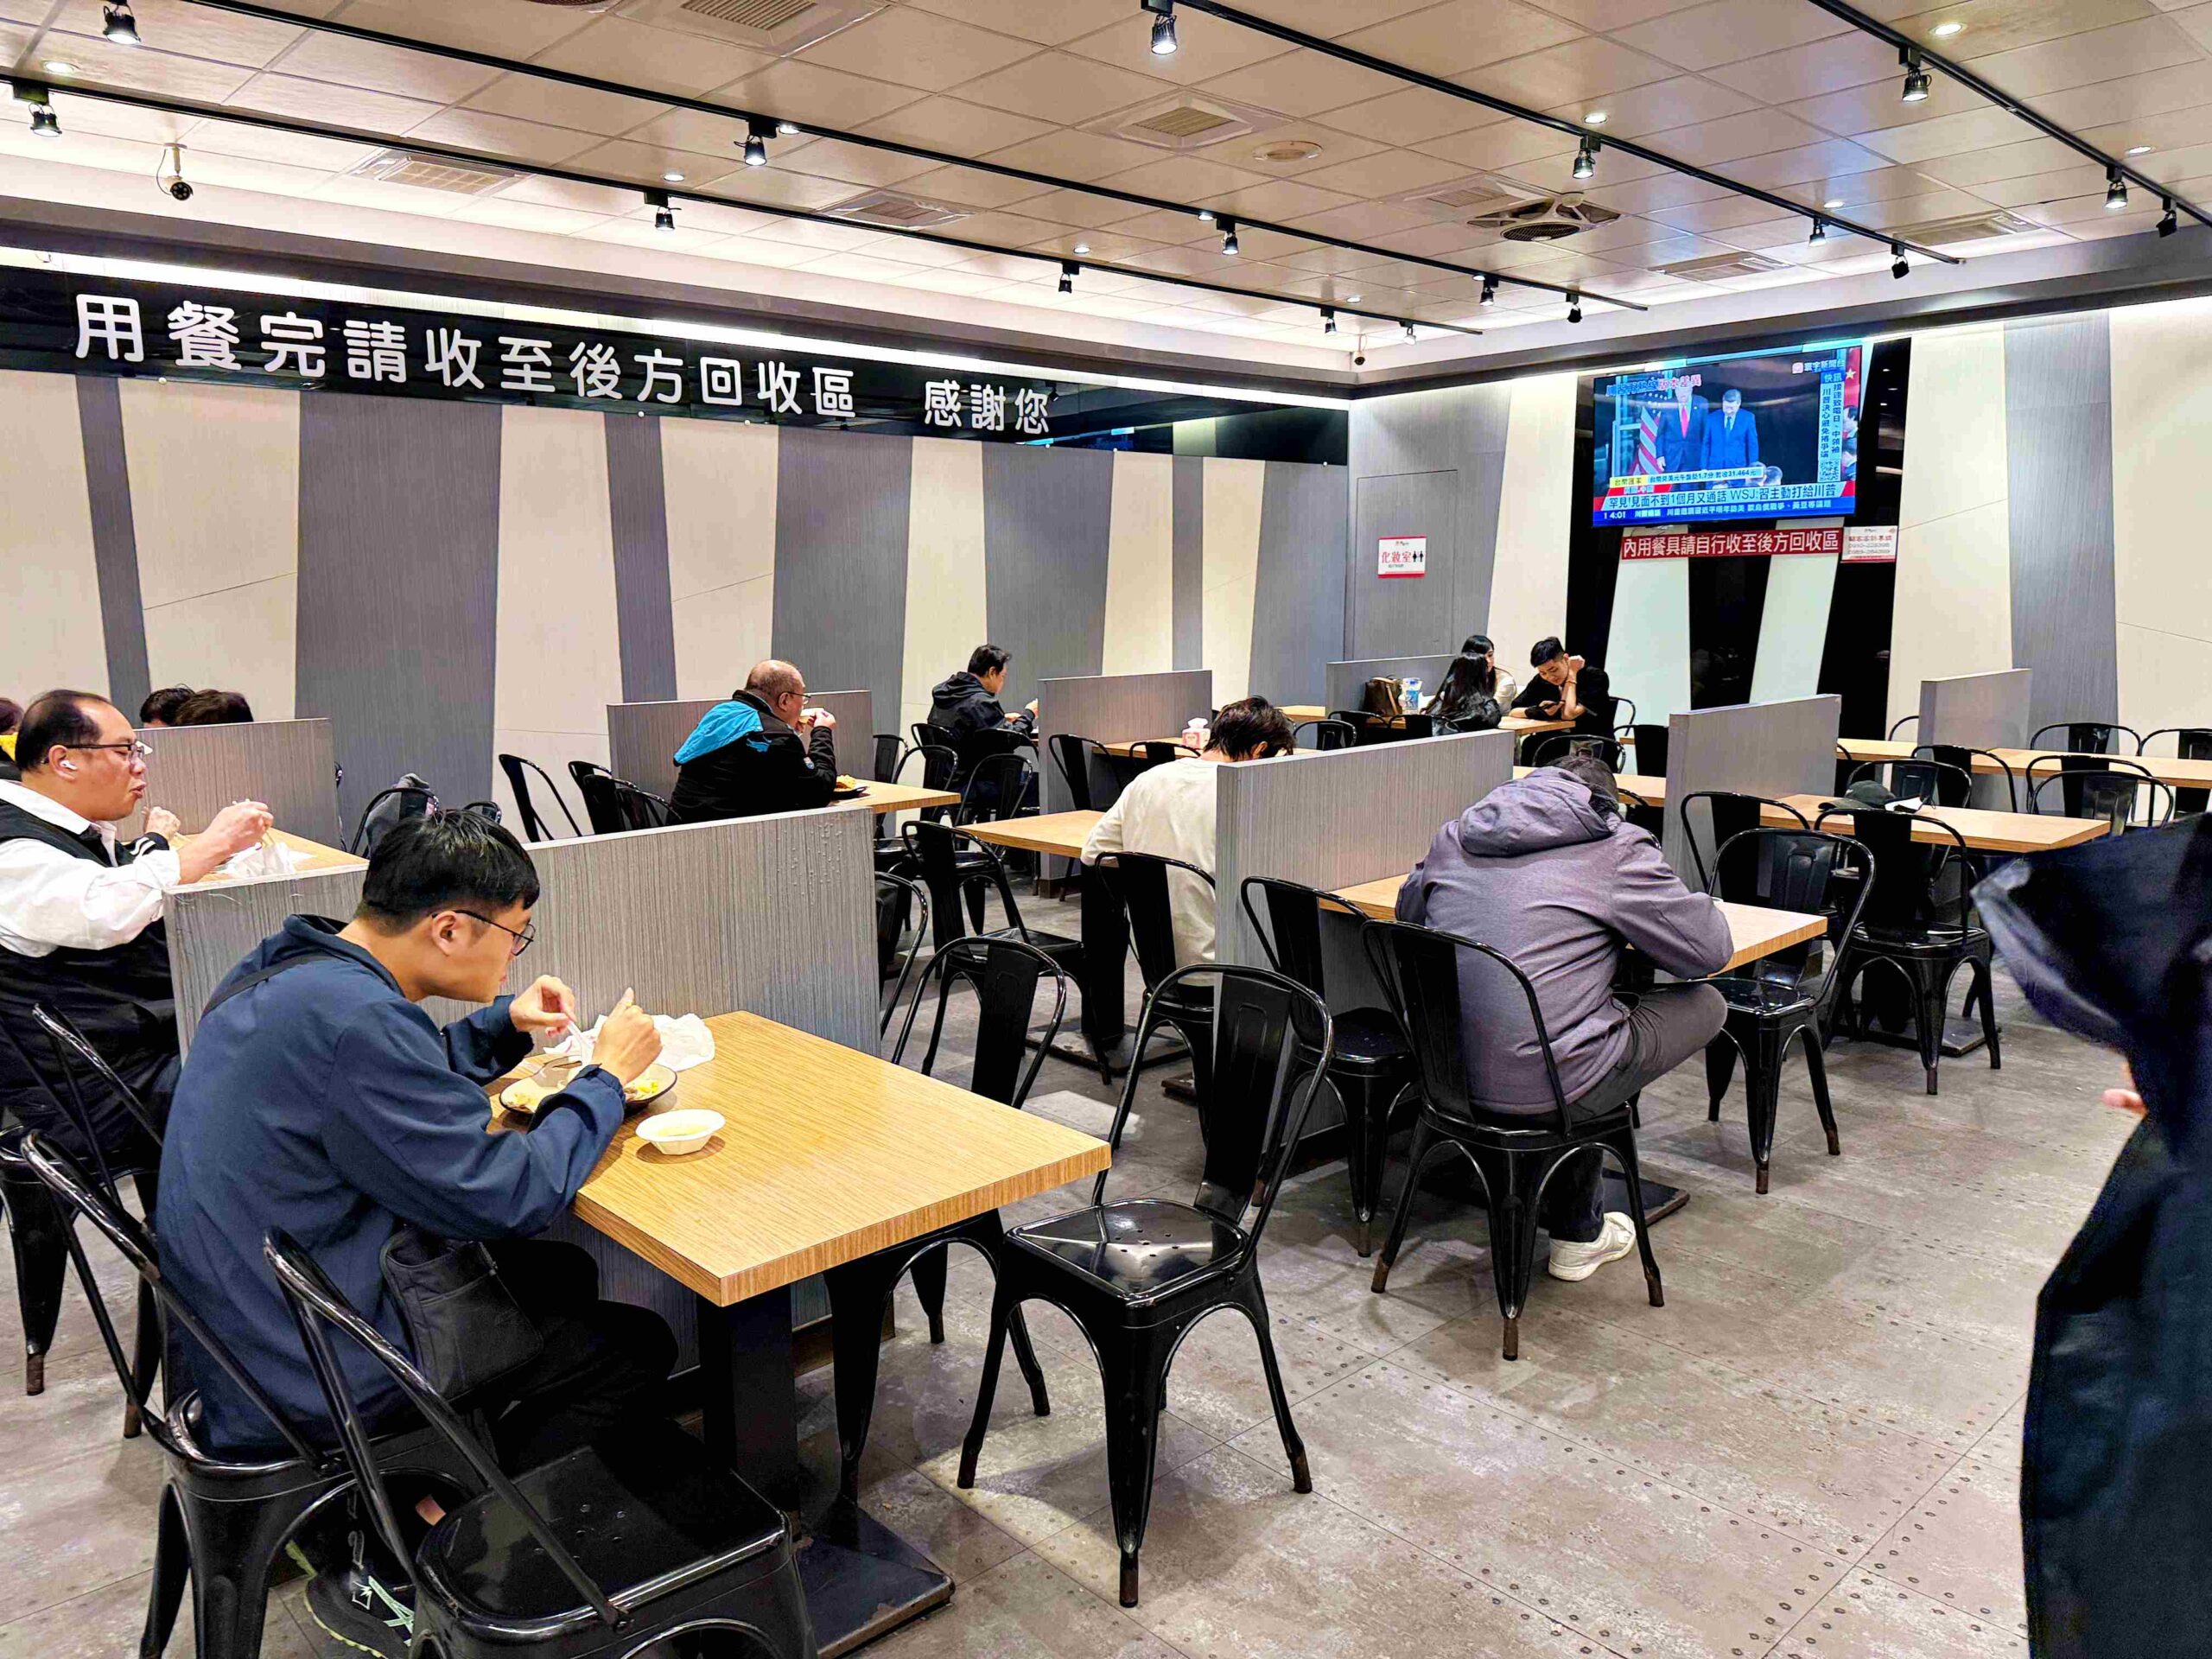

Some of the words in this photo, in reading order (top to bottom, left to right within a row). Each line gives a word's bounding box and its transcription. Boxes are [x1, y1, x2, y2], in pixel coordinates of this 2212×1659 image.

[75, 294, 855, 418] 用餐完請收至後方回收區
[924, 379, 1049, 434] 感謝您
[1624, 531, 1840, 558] 內用餐具請自行收至後方回收區
